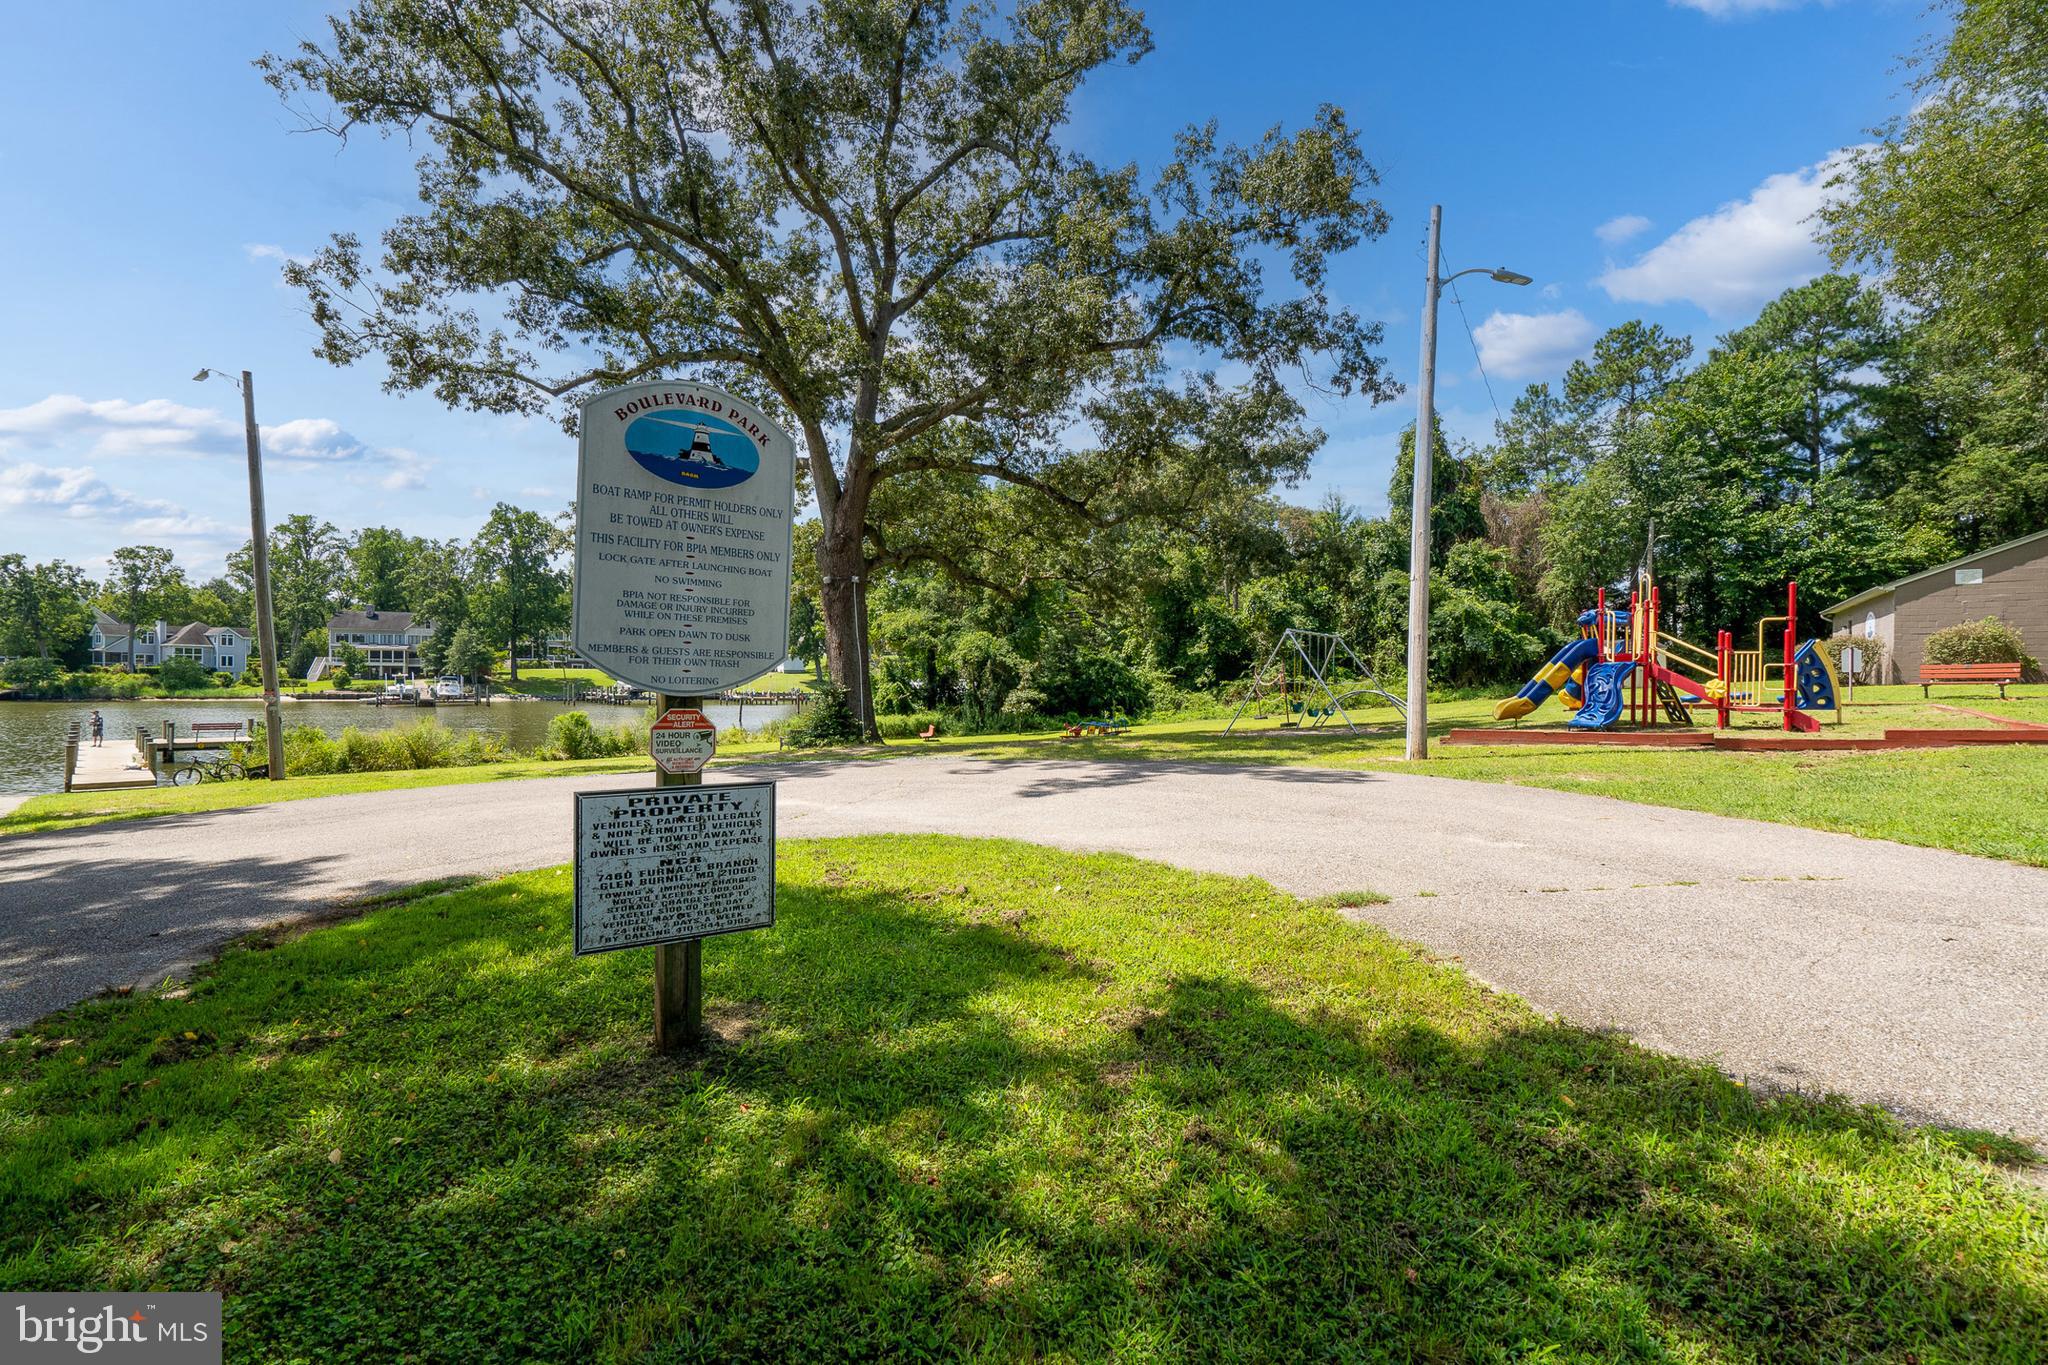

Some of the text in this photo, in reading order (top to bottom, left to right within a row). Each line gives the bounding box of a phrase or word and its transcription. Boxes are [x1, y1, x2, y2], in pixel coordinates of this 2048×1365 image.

[614, 392, 770, 447] BOULEVARD PARK
[592, 484, 784, 519] BOAT RAMP FOR PERMIT HOLDERS ONLY
[650, 505, 734, 525] ALL OTHERS WILL
[610, 513, 766, 541] BE TOWED AT OWNER'S EXPENSE
[590, 532, 780, 562] THIS FACILITY FOR BPIA MEMBERS ONLY
[599, 552, 772, 578] LOCK GATE AFTER LAUNCHING BOAT
[654, 575, 722, 588] NO SWIMMING
[622, 590, 750, 608] BPIA NOT RESPONSIBLE FOR
[616, 600, 657, 610] DAMAGE
[676, 604, 708, 614] INJURY
[710, 607, 755, 617] INCURRED
[624, 610, 748, 626] WHILE ON THESE PREMISES
[620, 627, 750, 642] PARK OPEN DAWN TO DUSK
[588, 644, 774, 660] MEMBERS & GUESTS ARE RESPONSIBLE
[629, 656, 740, 668] FOR THEIR OWN TRASH
[650, 676, 719, 686] NO LOITERING
[629, 792, 731, 807] PRIVATE
[614, 801, 742, 819] PROPERTY
[708, 811, 761, 821] ILLEGALLY
[608, 824, 706, 838] NON-PERMITTED
[712, 819, 762, 830] VEHICLES
[590, 836, 763, 858] OWNER'S RISK AND EXPENSE
[603, 840, 632, 848] WILL
[658, 834, 698, 843] TOWED
[704, 830, 734, 838] AWAY
[640, 864, 700, 878] FURNACE
[707, 858, 758, 870] BRANCH
[600, 880, 633, 890] GLEN
[696, 872, 714, 880] MD
